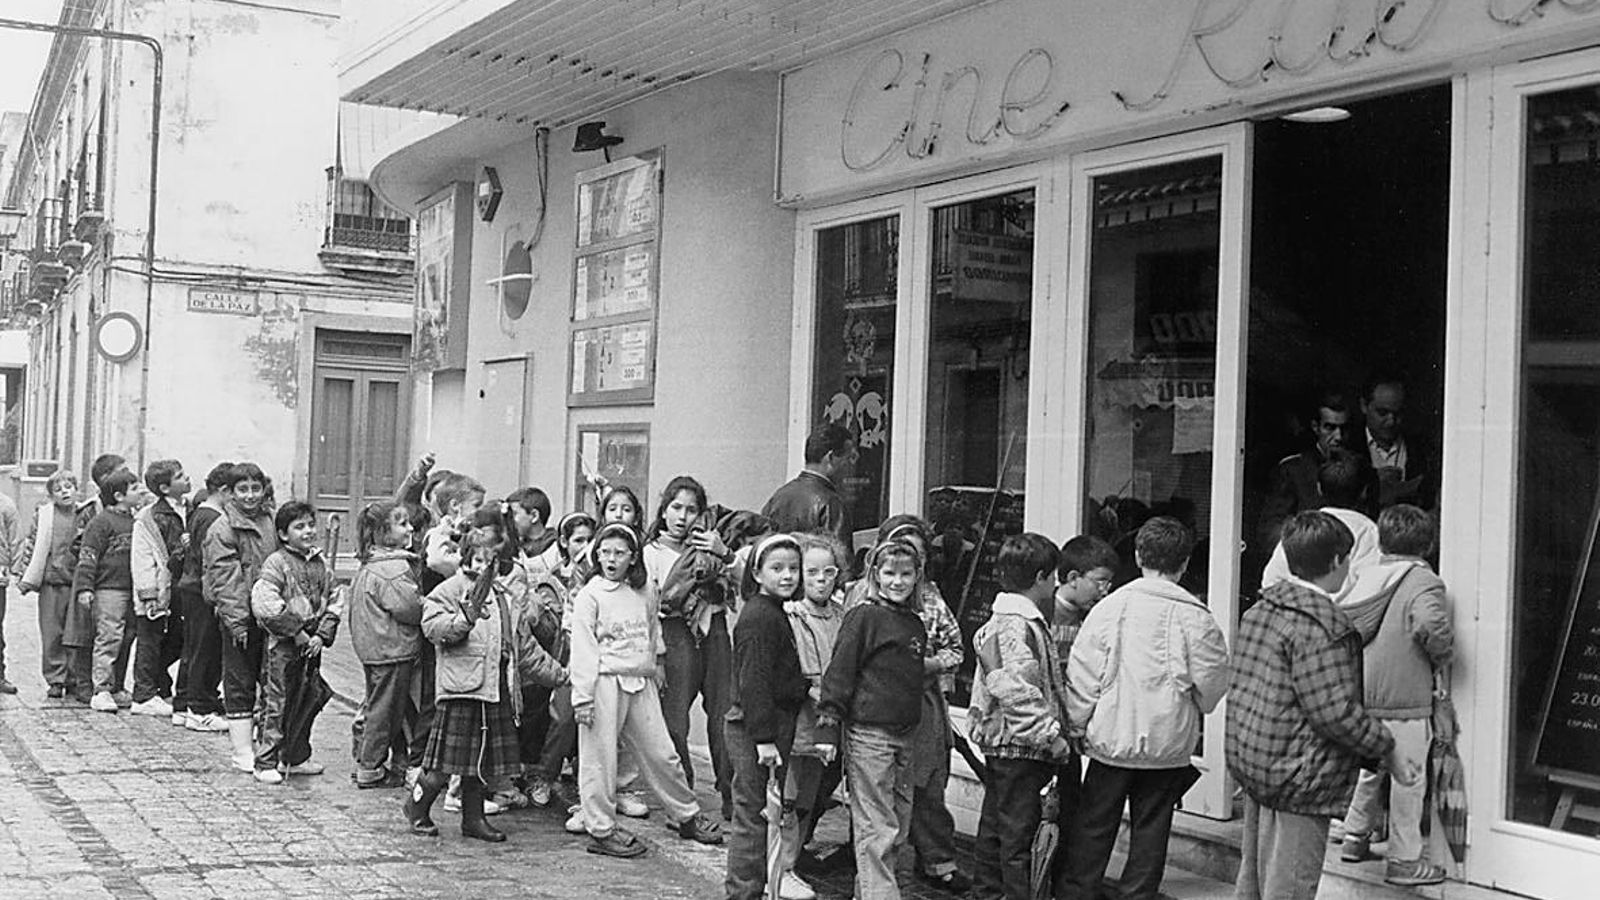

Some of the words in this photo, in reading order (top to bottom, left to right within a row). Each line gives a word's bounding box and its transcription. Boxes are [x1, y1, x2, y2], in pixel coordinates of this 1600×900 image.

[842, 49, 1071, 172] Cine
[205, 294, 239, 302] CALLE
[229, 303, 251, 311] PAZ
